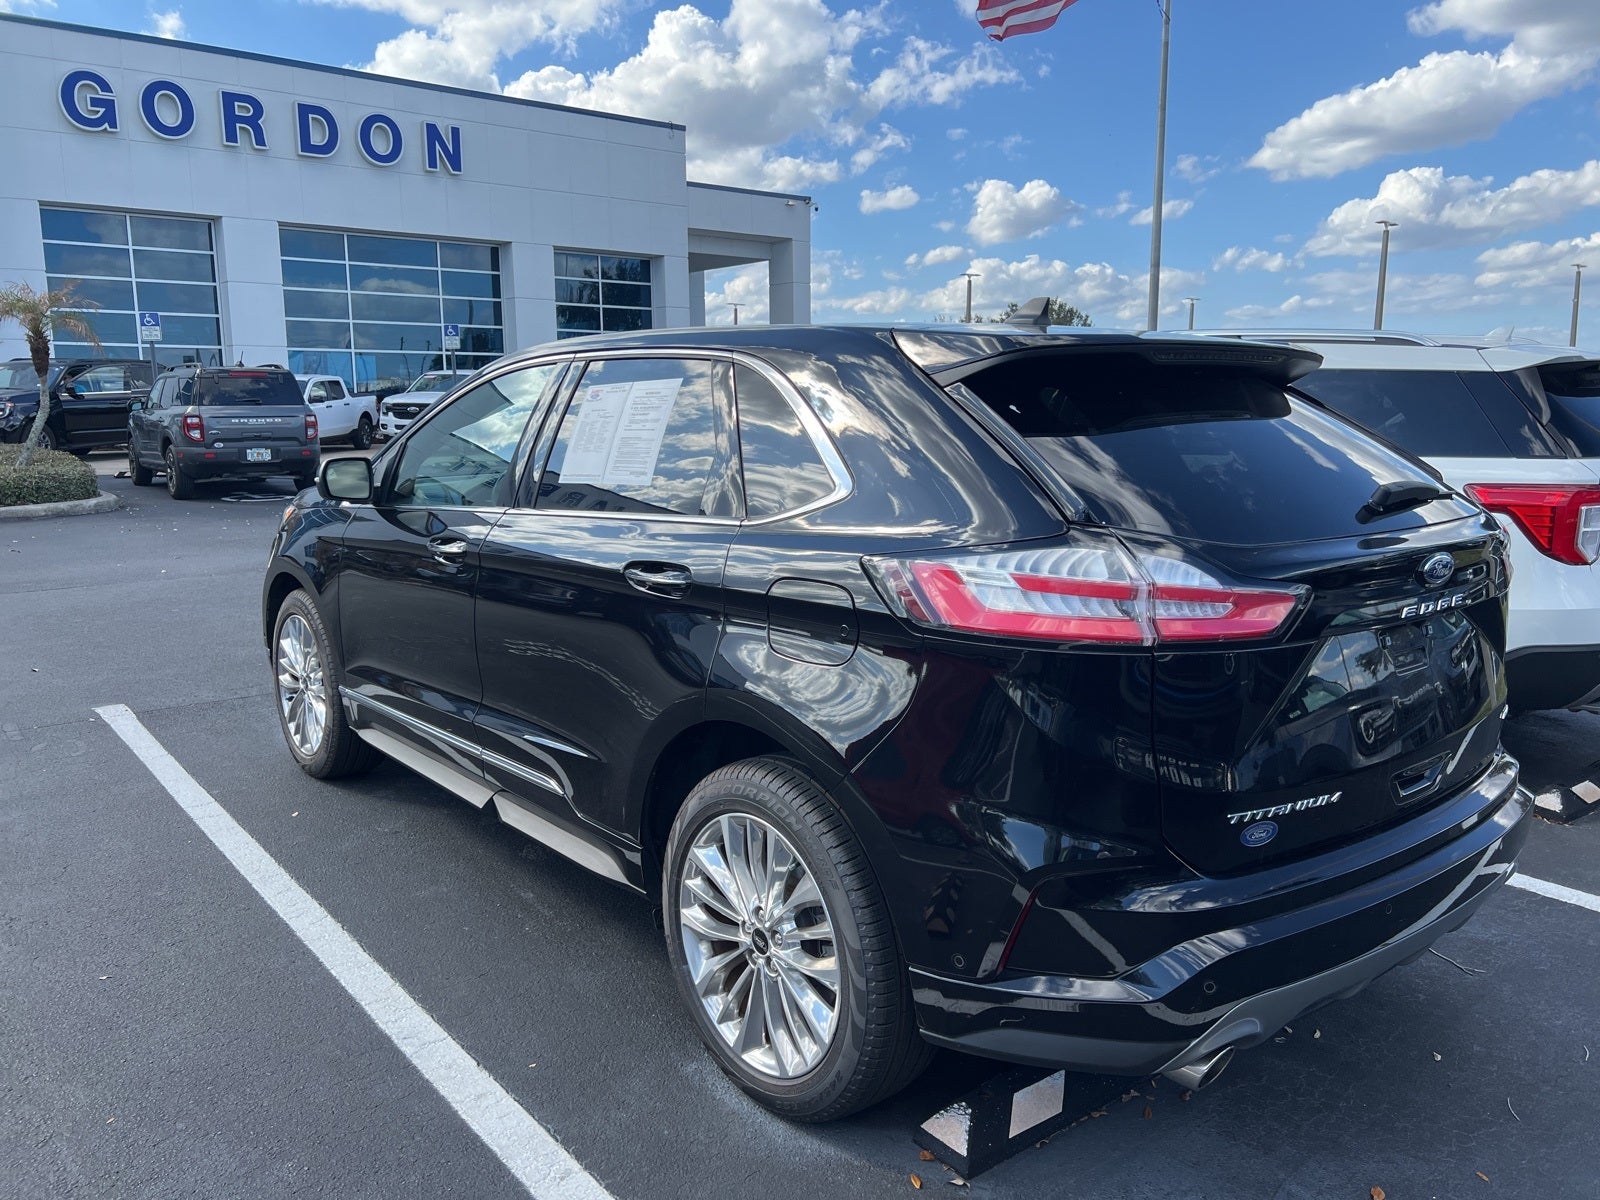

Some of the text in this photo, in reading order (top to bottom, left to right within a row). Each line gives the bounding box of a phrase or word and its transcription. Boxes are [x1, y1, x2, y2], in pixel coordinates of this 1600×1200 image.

[59, 70, 463, 175] GORDON
[1401, 594, 1464, 619] EDGE
[1227, 792, 1343, 824] TITANIUM
